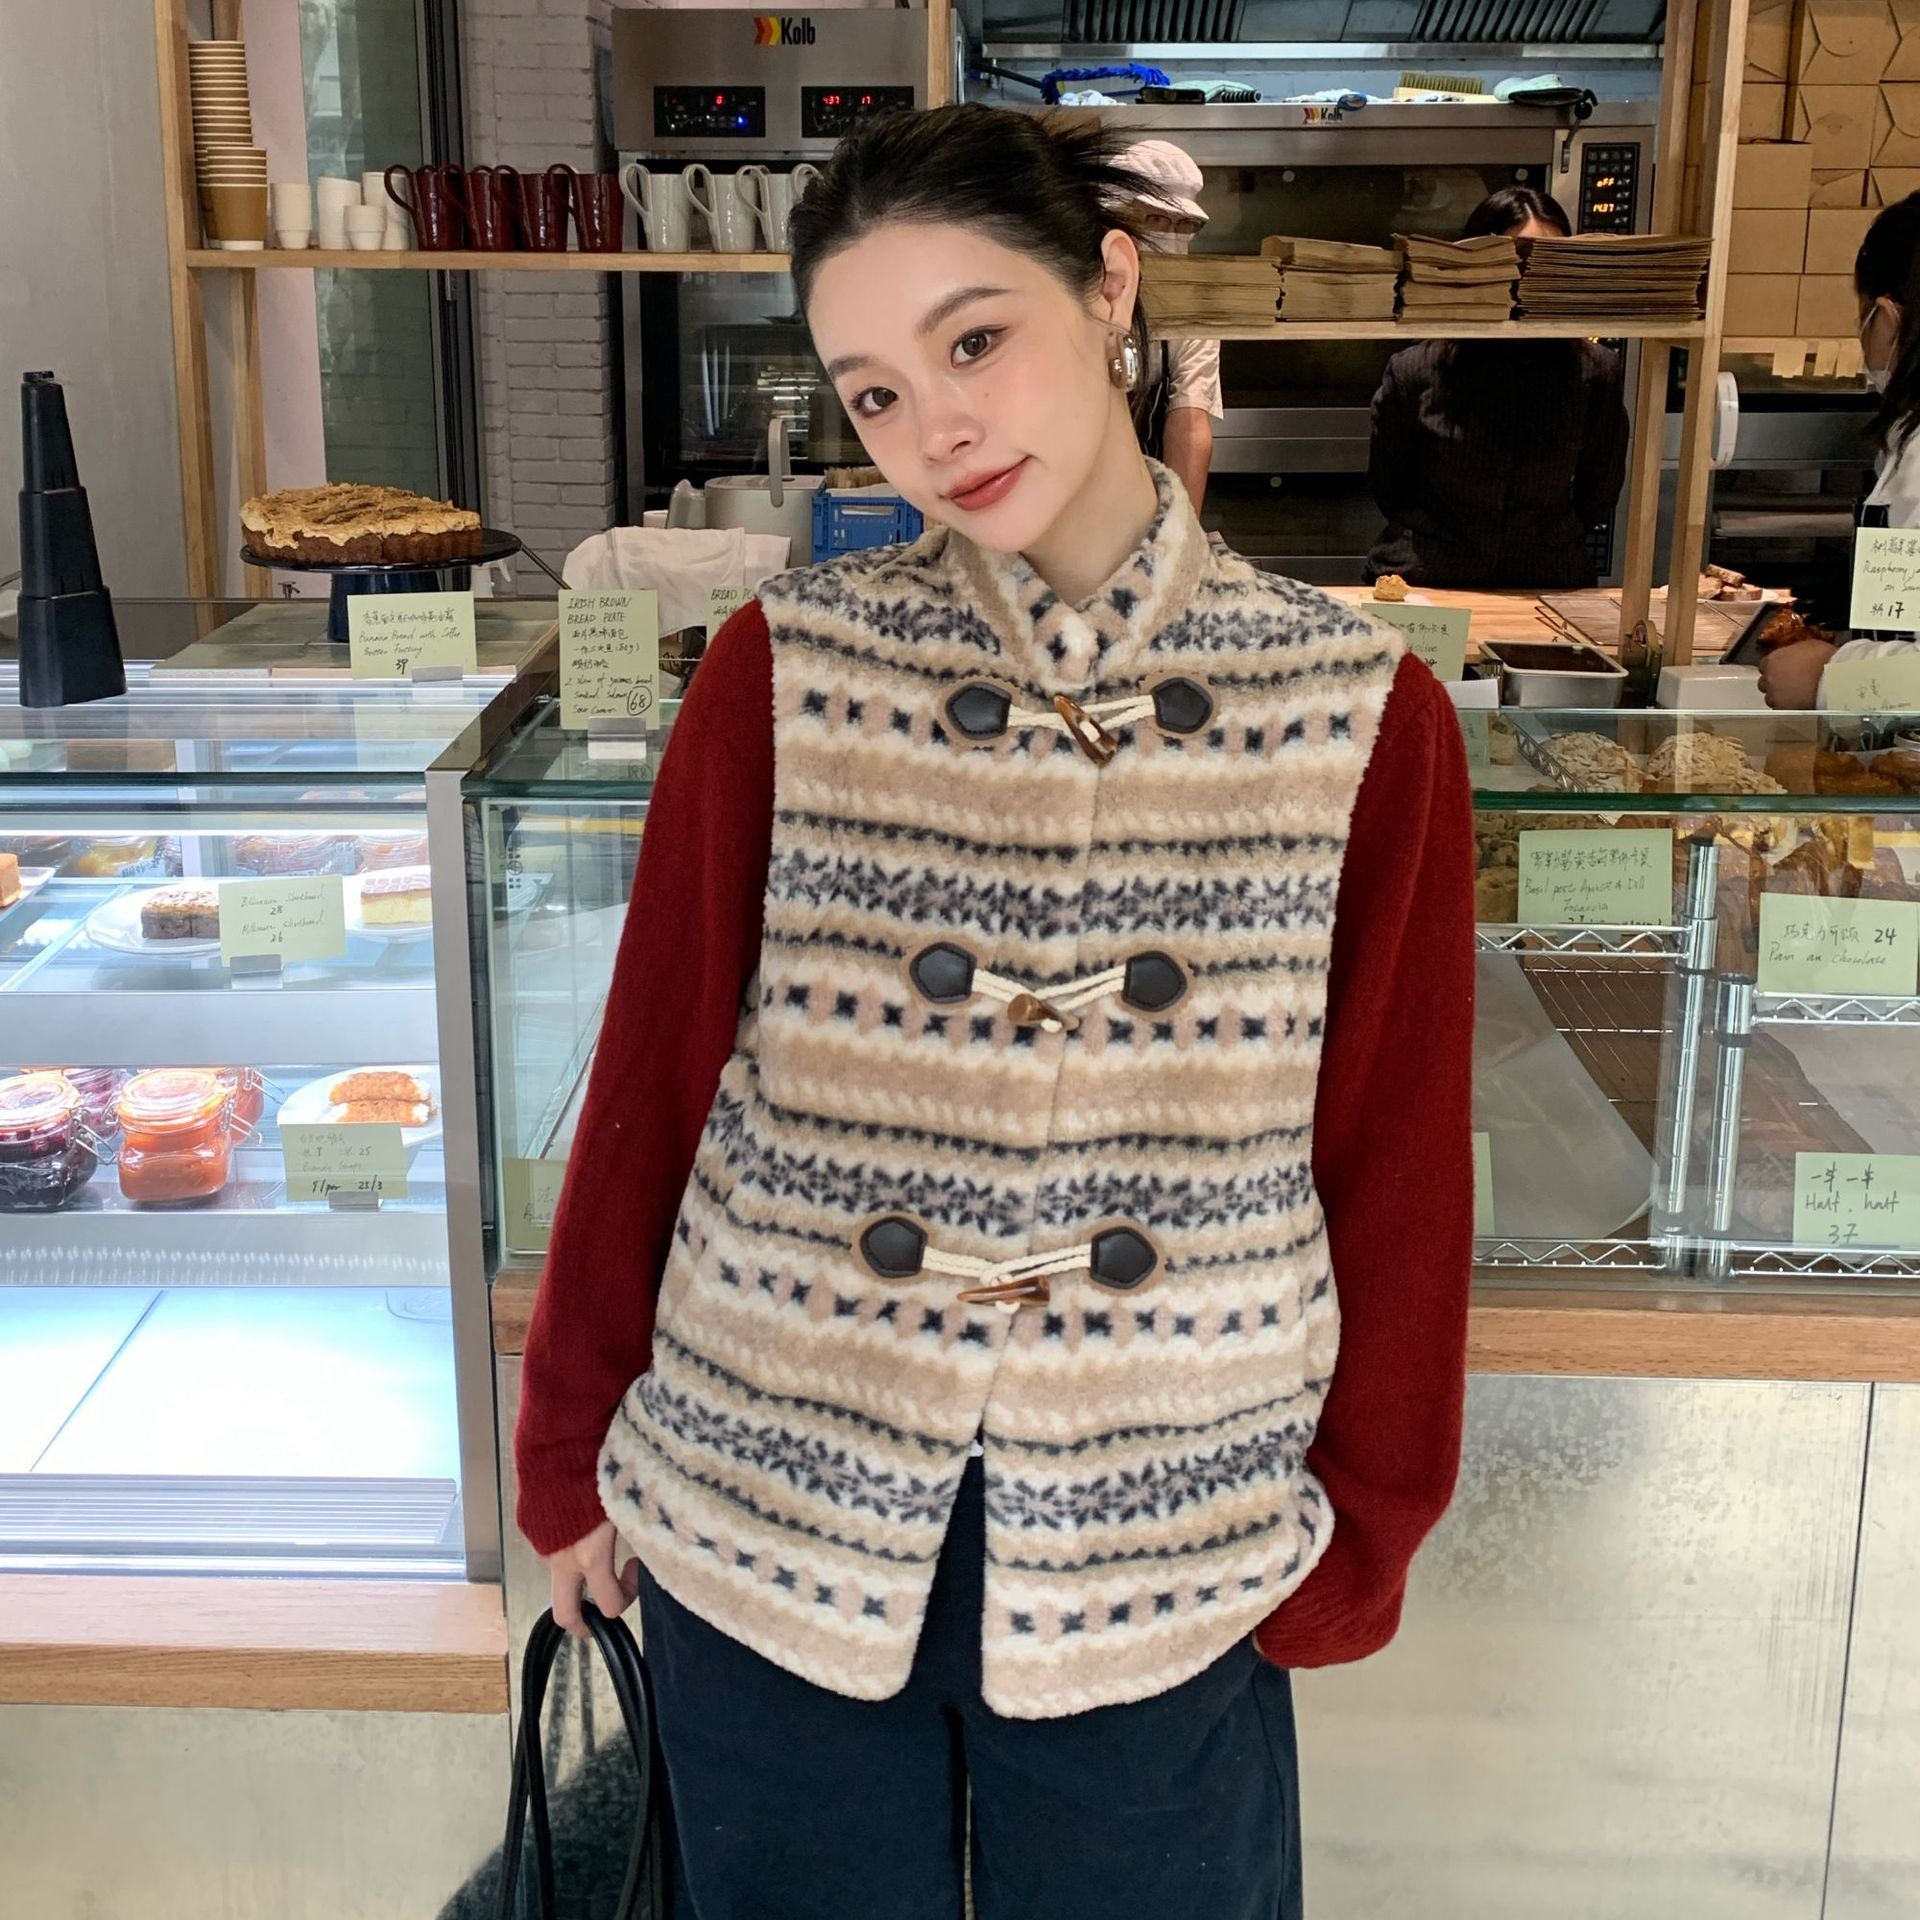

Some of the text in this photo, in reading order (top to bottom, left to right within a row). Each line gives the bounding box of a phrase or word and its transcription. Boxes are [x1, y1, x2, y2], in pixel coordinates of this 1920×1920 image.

[781, 17, 816, 45] Kolb
[568, 597, 632, 609] IRISH BROWN
[1887, 601, 1904, 619] 17
[567, 611, 626, 625] BREAD PLATE
[395, 658, 409, 675] 39
[1874, 927, 1897, 946] 24
[1768, 941, 1794, 961] Pain
[1805, 1190, 1900, 1213] Half half
[1828, 1223, 1858, 1244] 37
